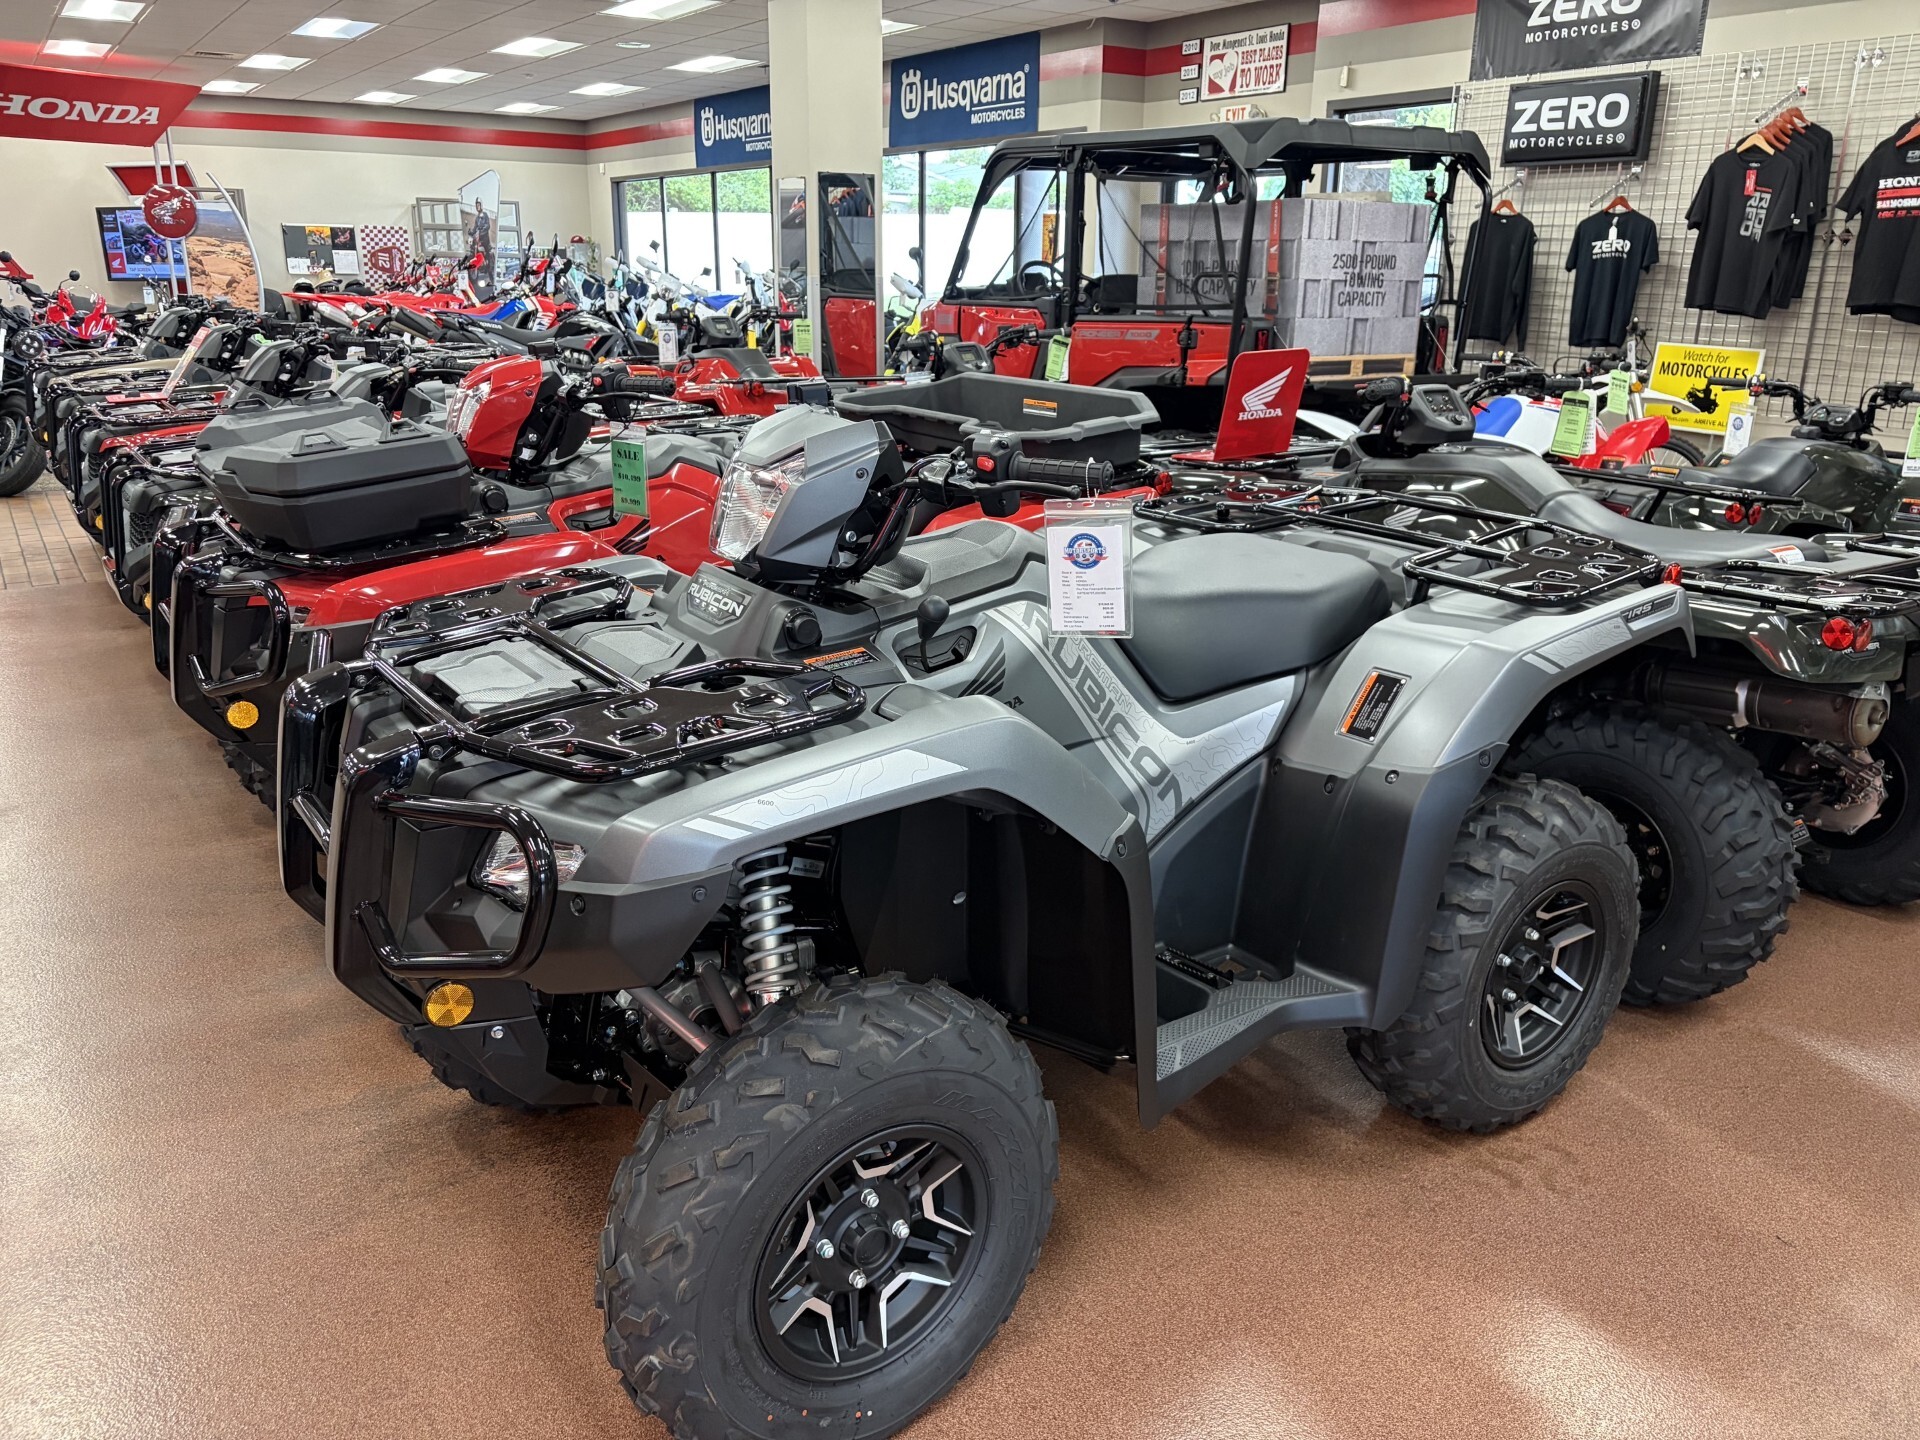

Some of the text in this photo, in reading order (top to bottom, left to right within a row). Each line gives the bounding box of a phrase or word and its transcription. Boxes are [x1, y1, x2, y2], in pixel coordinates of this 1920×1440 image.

[1256, 31, 1268, 45] Louis
[1268, 28, 1285, 43] Honda
[1183, 42, 1198, 53] 2010
[1241, 44, 1284, 65] BEST PLACES
[1183, 68, 1197, 77] 2011
[1212, 62, 1235, 80] my job
[1239, 63, 1282, 89] TO WORK
[1181, 91, 1195, 101] 2012
[0, 93, 160, 125] HONDA
[971, 107, 1025, 125] MOTORCYCLES
[1510, 93, 1630, 133] ZERO
[715, 112, 770, 141] Husqvarn
[1591, 239, 1631, 254] ZERO
[1332, 253, 1397, 270] 2500-POUND
[1343, 271, 1385, 288] TOWING
[1337, 291, 1386, 307] CAPACITY
[1683, 350, 1730, 364] Watch for
[1237, 408, 1283, 421] HONDA
[1693, 418, 1717, 426] ARRIVE
[616, 448, 640, 461] SALE
[687, 582, 744, 617] RUBICON
[1628, 602, 1653, 619] IRS
[1352, 684, 1371, 713] WARNING
[757, 798, 775, 807] 6600
